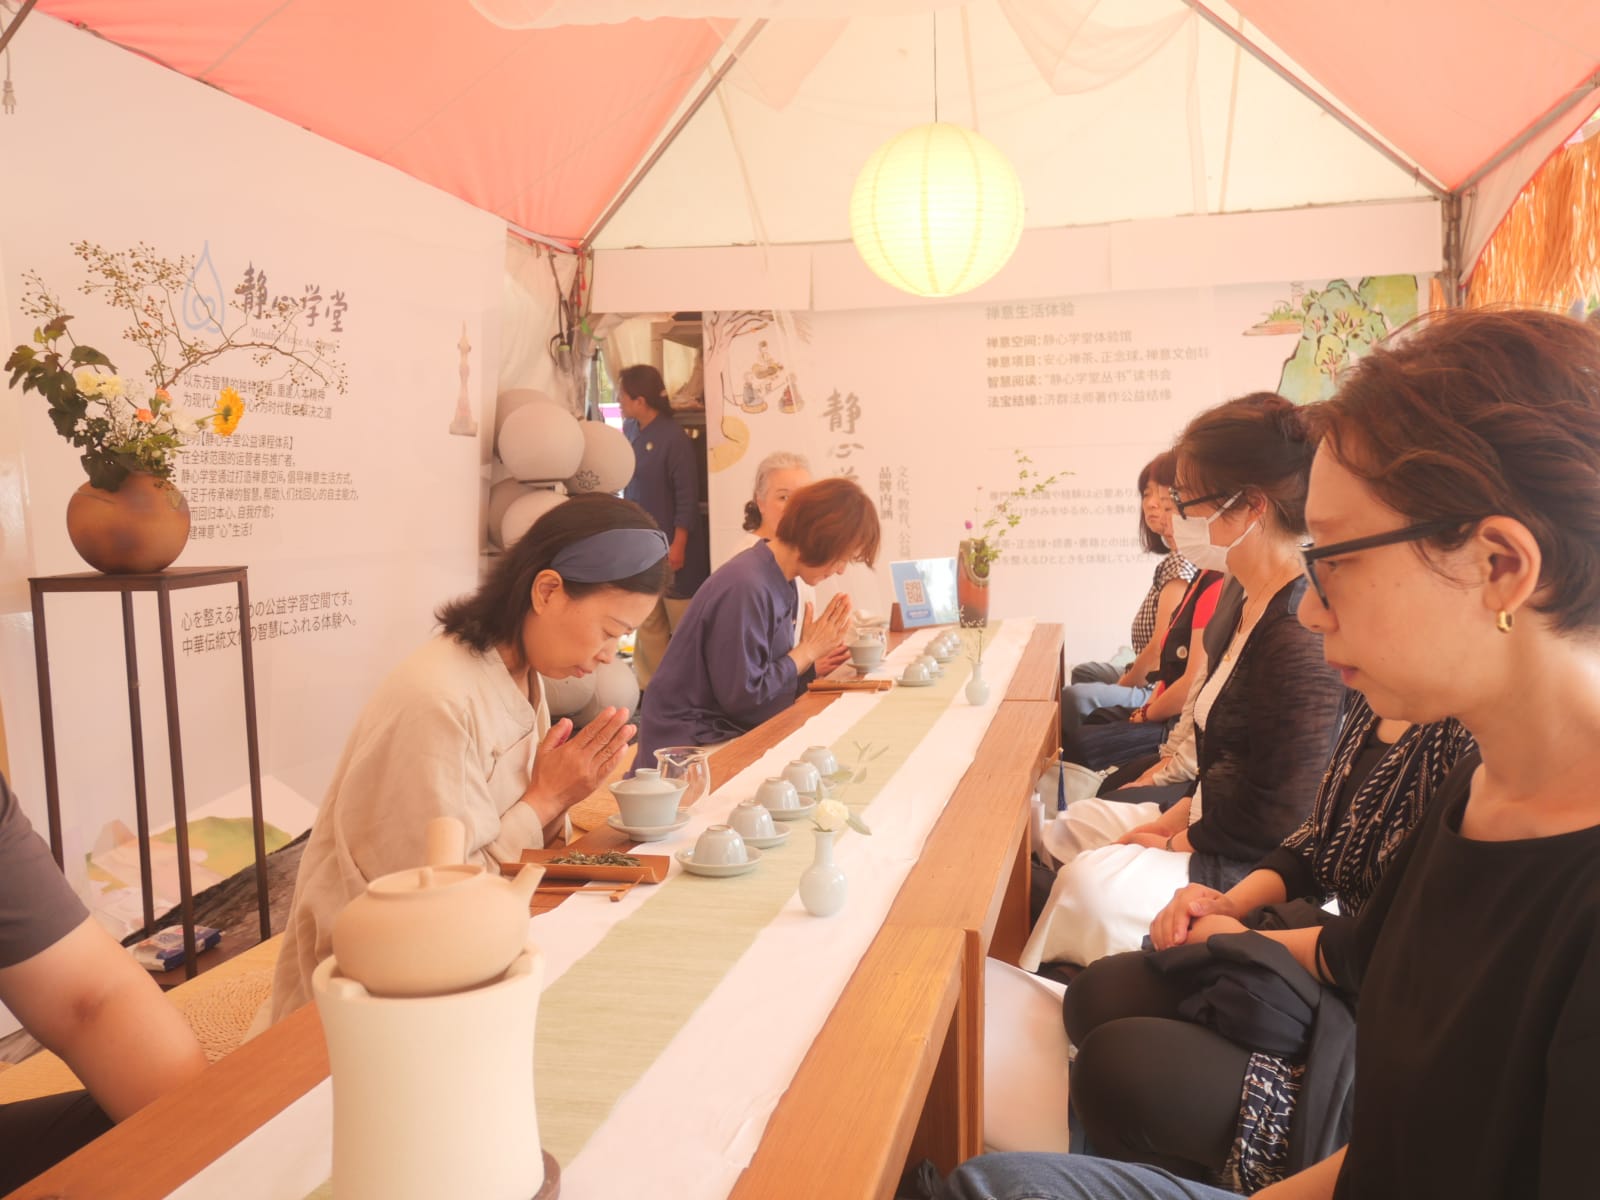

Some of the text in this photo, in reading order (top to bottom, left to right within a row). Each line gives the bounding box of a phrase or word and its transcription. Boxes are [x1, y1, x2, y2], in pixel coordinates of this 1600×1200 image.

[985, 302, 1075, 320] 禅意生活体验
